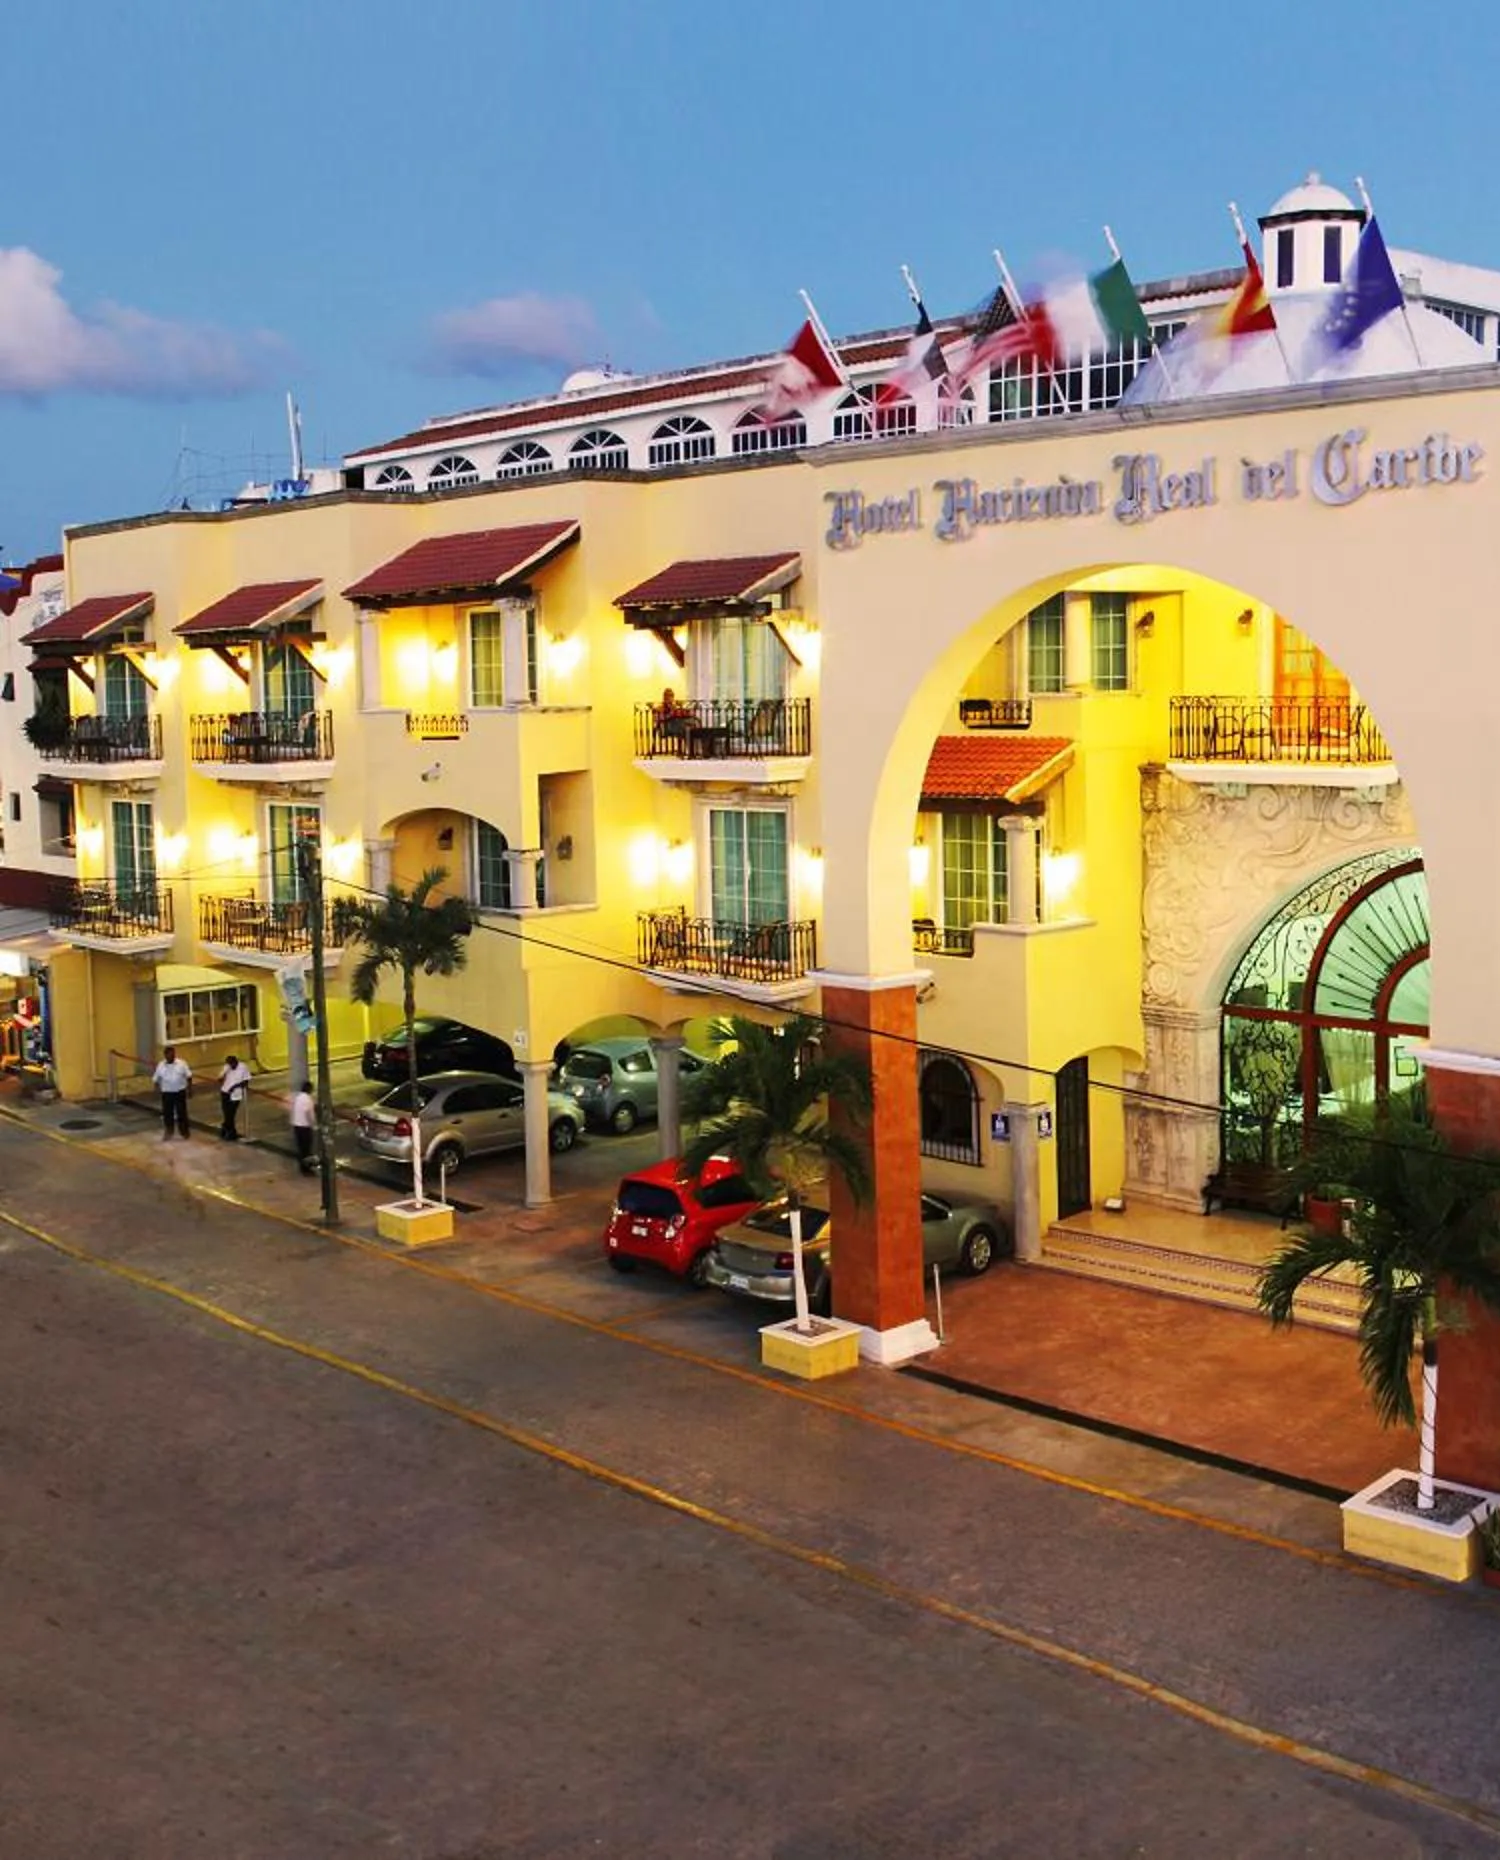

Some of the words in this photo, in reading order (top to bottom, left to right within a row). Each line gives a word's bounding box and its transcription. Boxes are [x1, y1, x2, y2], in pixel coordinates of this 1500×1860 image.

[824, 488, 922, 550] Hotel
[933, 475, 1105, 541] Hacienda
[1112, 452, 1219, 525] Real
[1240, 448, 1299, 501] del
[1312, 428, 1484, 506] Caribe
